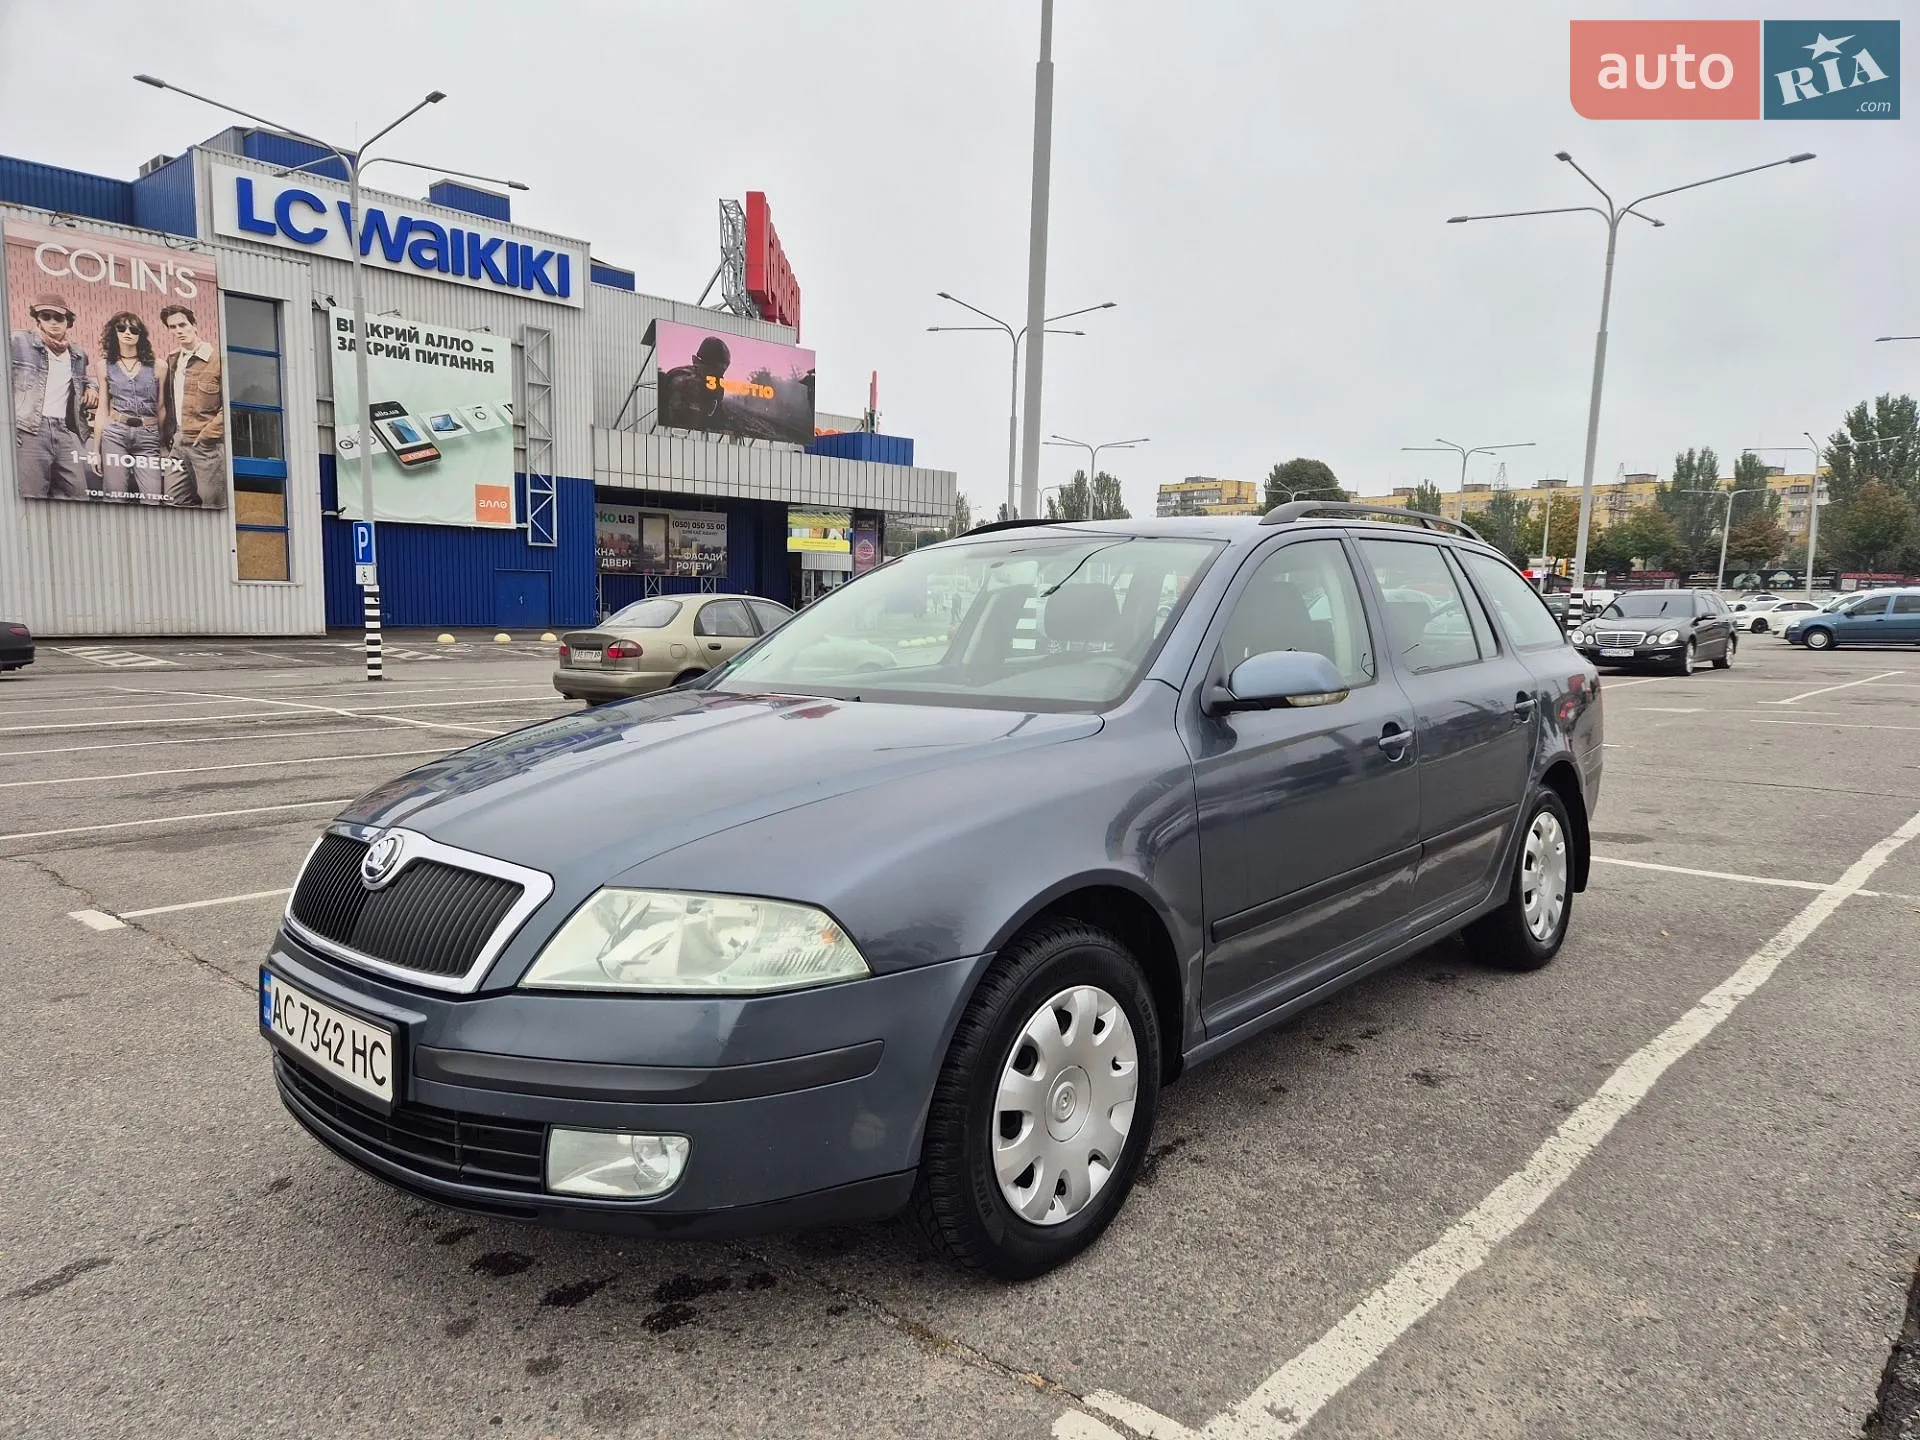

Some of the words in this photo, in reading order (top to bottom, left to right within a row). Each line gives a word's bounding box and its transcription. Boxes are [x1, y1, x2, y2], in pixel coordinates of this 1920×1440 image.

[235, 176, 328, 245] LC
[35, 242, 198, 299] COLIN'S
[336, 317, 420, 344] ВІКРИЙ
[425, 332, 475, 353] АЛЛО
[415, 348, 494, 374] ПИТАННЯ
[70, 450, 99, 465] 1-й
[105, 453, 185, 474] ПОВЕРХ
[85, 489, 104, 497] ТОВ
[672, 520, 690, 530] (050)
[715, 523, 726, 531] 00
[357, 526, 369, 560] P
[601, 558, 632, 568] ДВЕРІ
[676, 561, 713, 571] РОЛЕТИ
[683, 552, 723, 562] ФАСАДИ
[272, 986, 296, 1037] AC
[299, 1002, 345, 1068] 7342
[351, 1029, 387, 1087] HC
